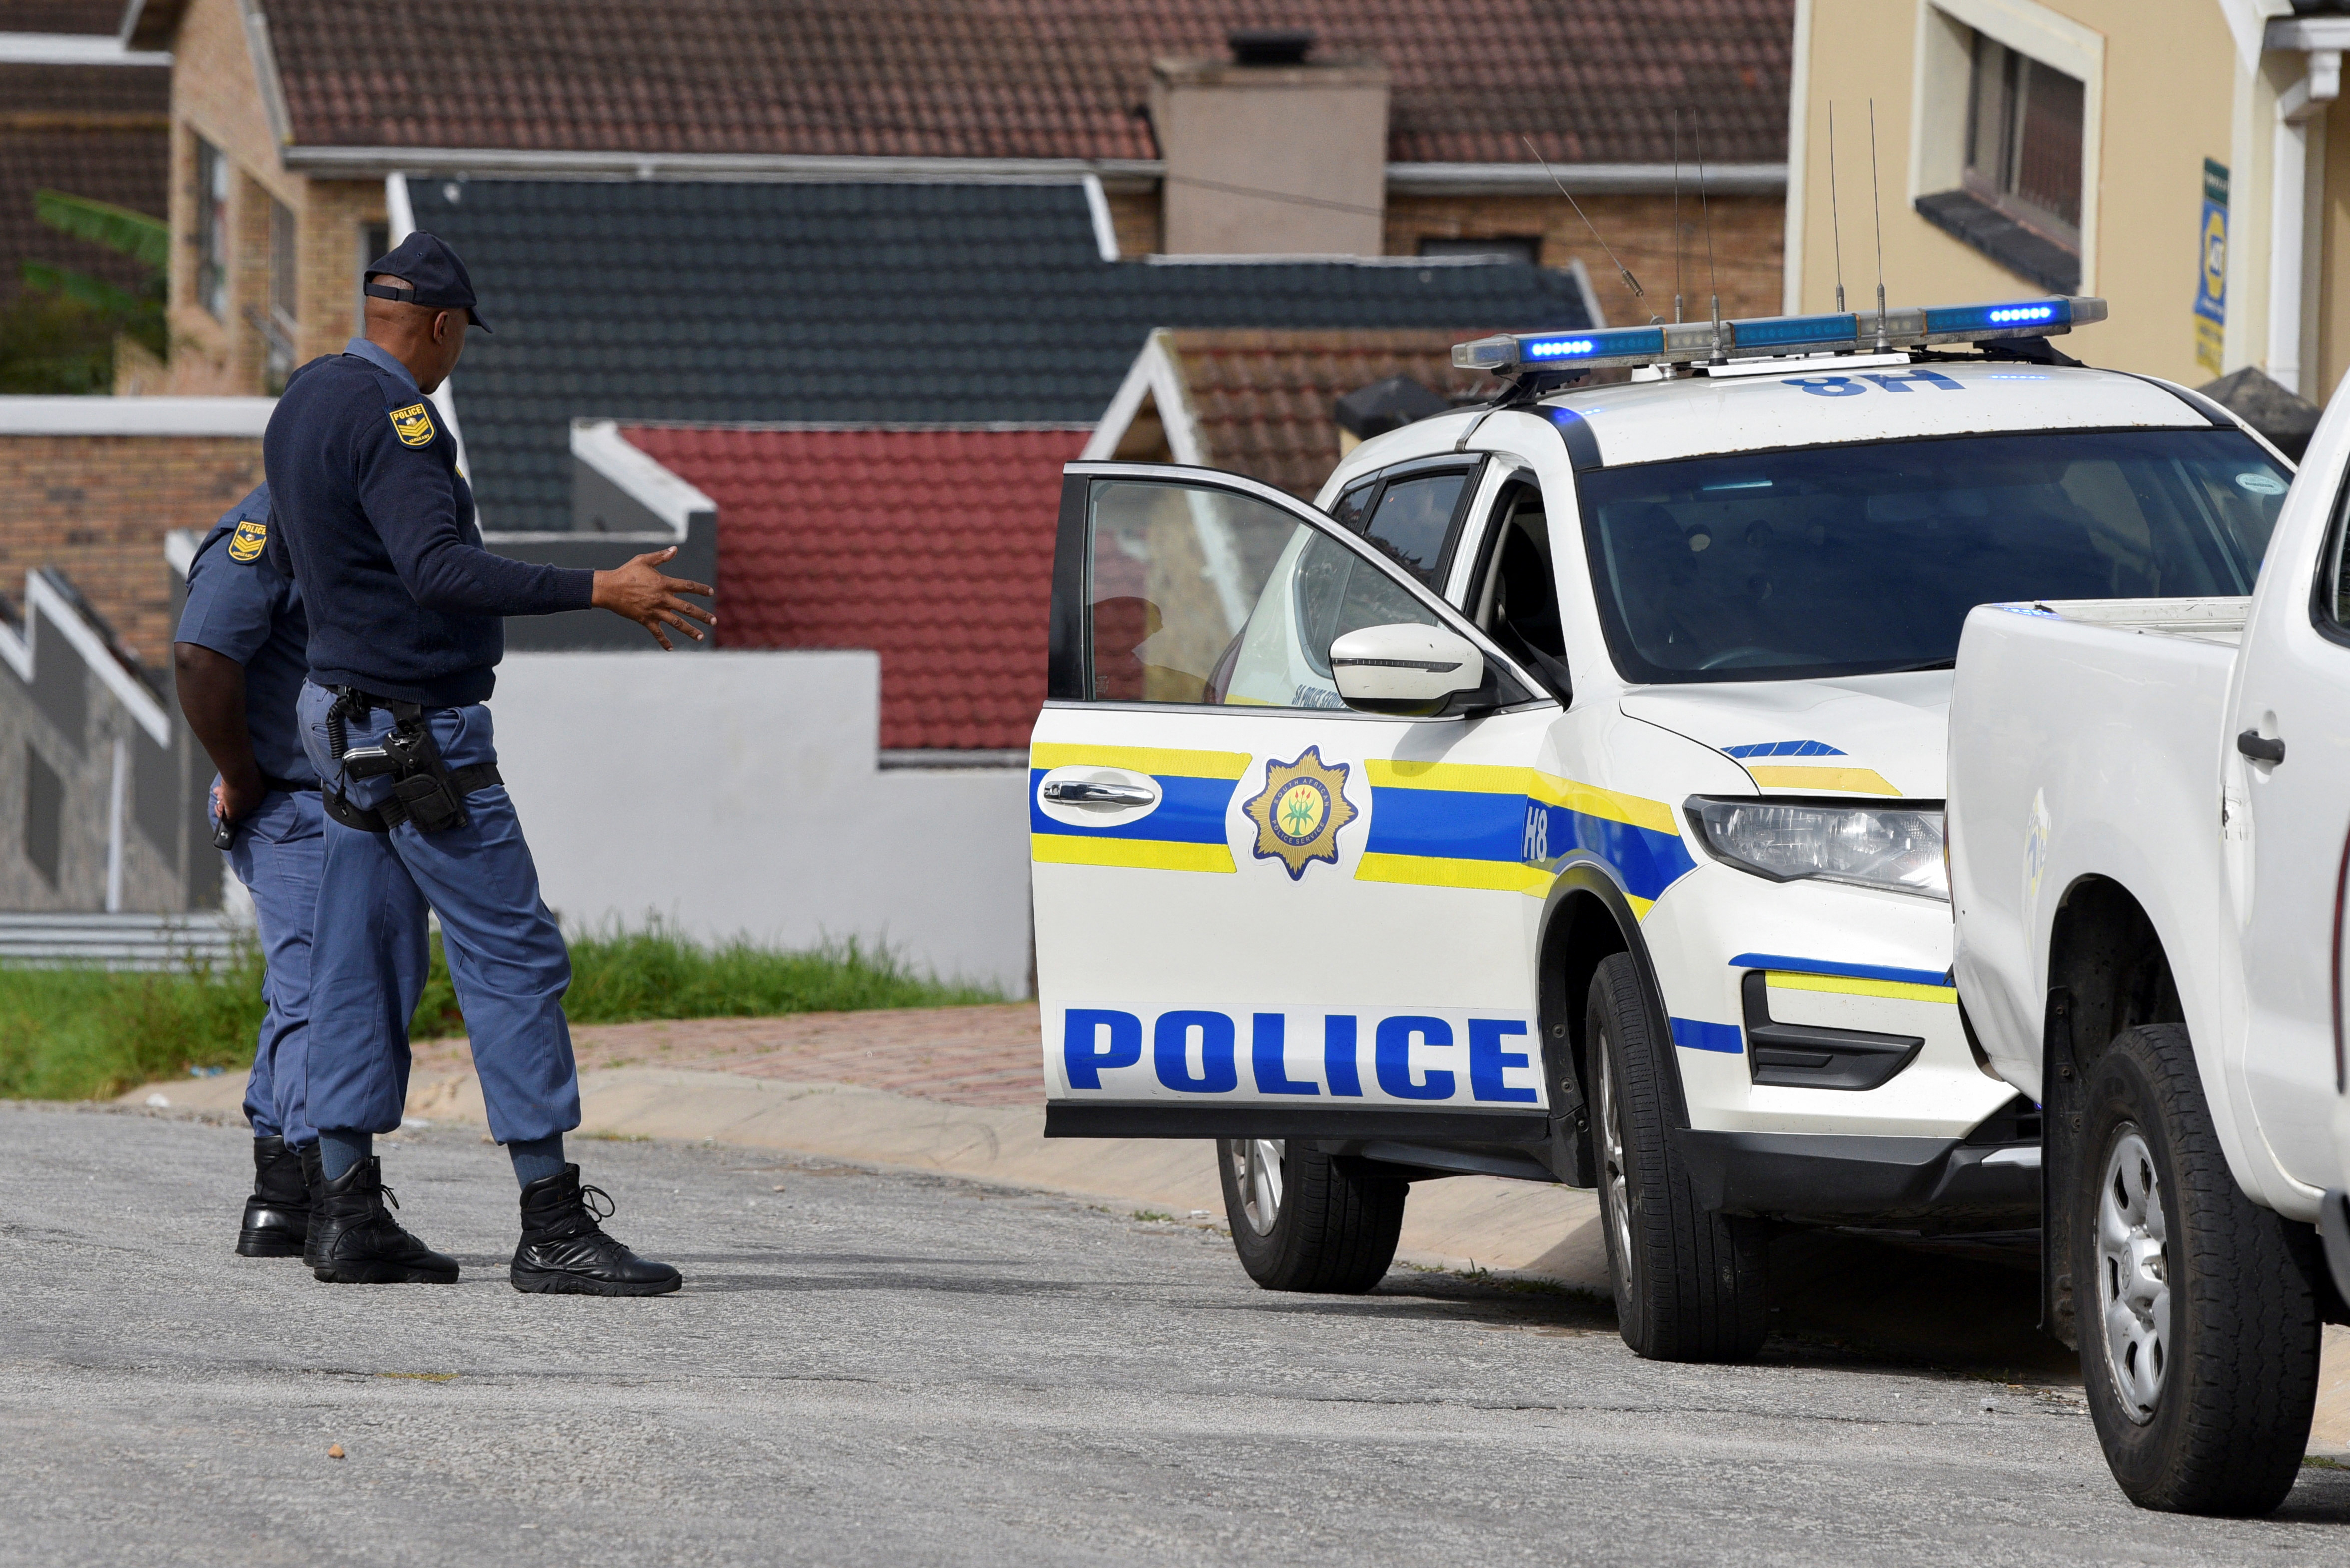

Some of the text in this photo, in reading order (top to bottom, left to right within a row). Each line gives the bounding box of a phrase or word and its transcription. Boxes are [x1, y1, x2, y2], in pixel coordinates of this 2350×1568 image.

[394, 407, 423, 421] POLICE
[409, 434, 430, 443] SERGEANT
[240, 524, 266, 535] POLICE
[1292, 684, 1307, 706] SA
[1300, 686, 1327, 707] POLICE
[1274, 778, 1329, 806] SOUTH AFRICAN
[1272, 820, 1324, 844] POLICE SERVICE
[1523, 806, 1547, 863] H8
[1064, 1009, 1538, 1103] POLICE
